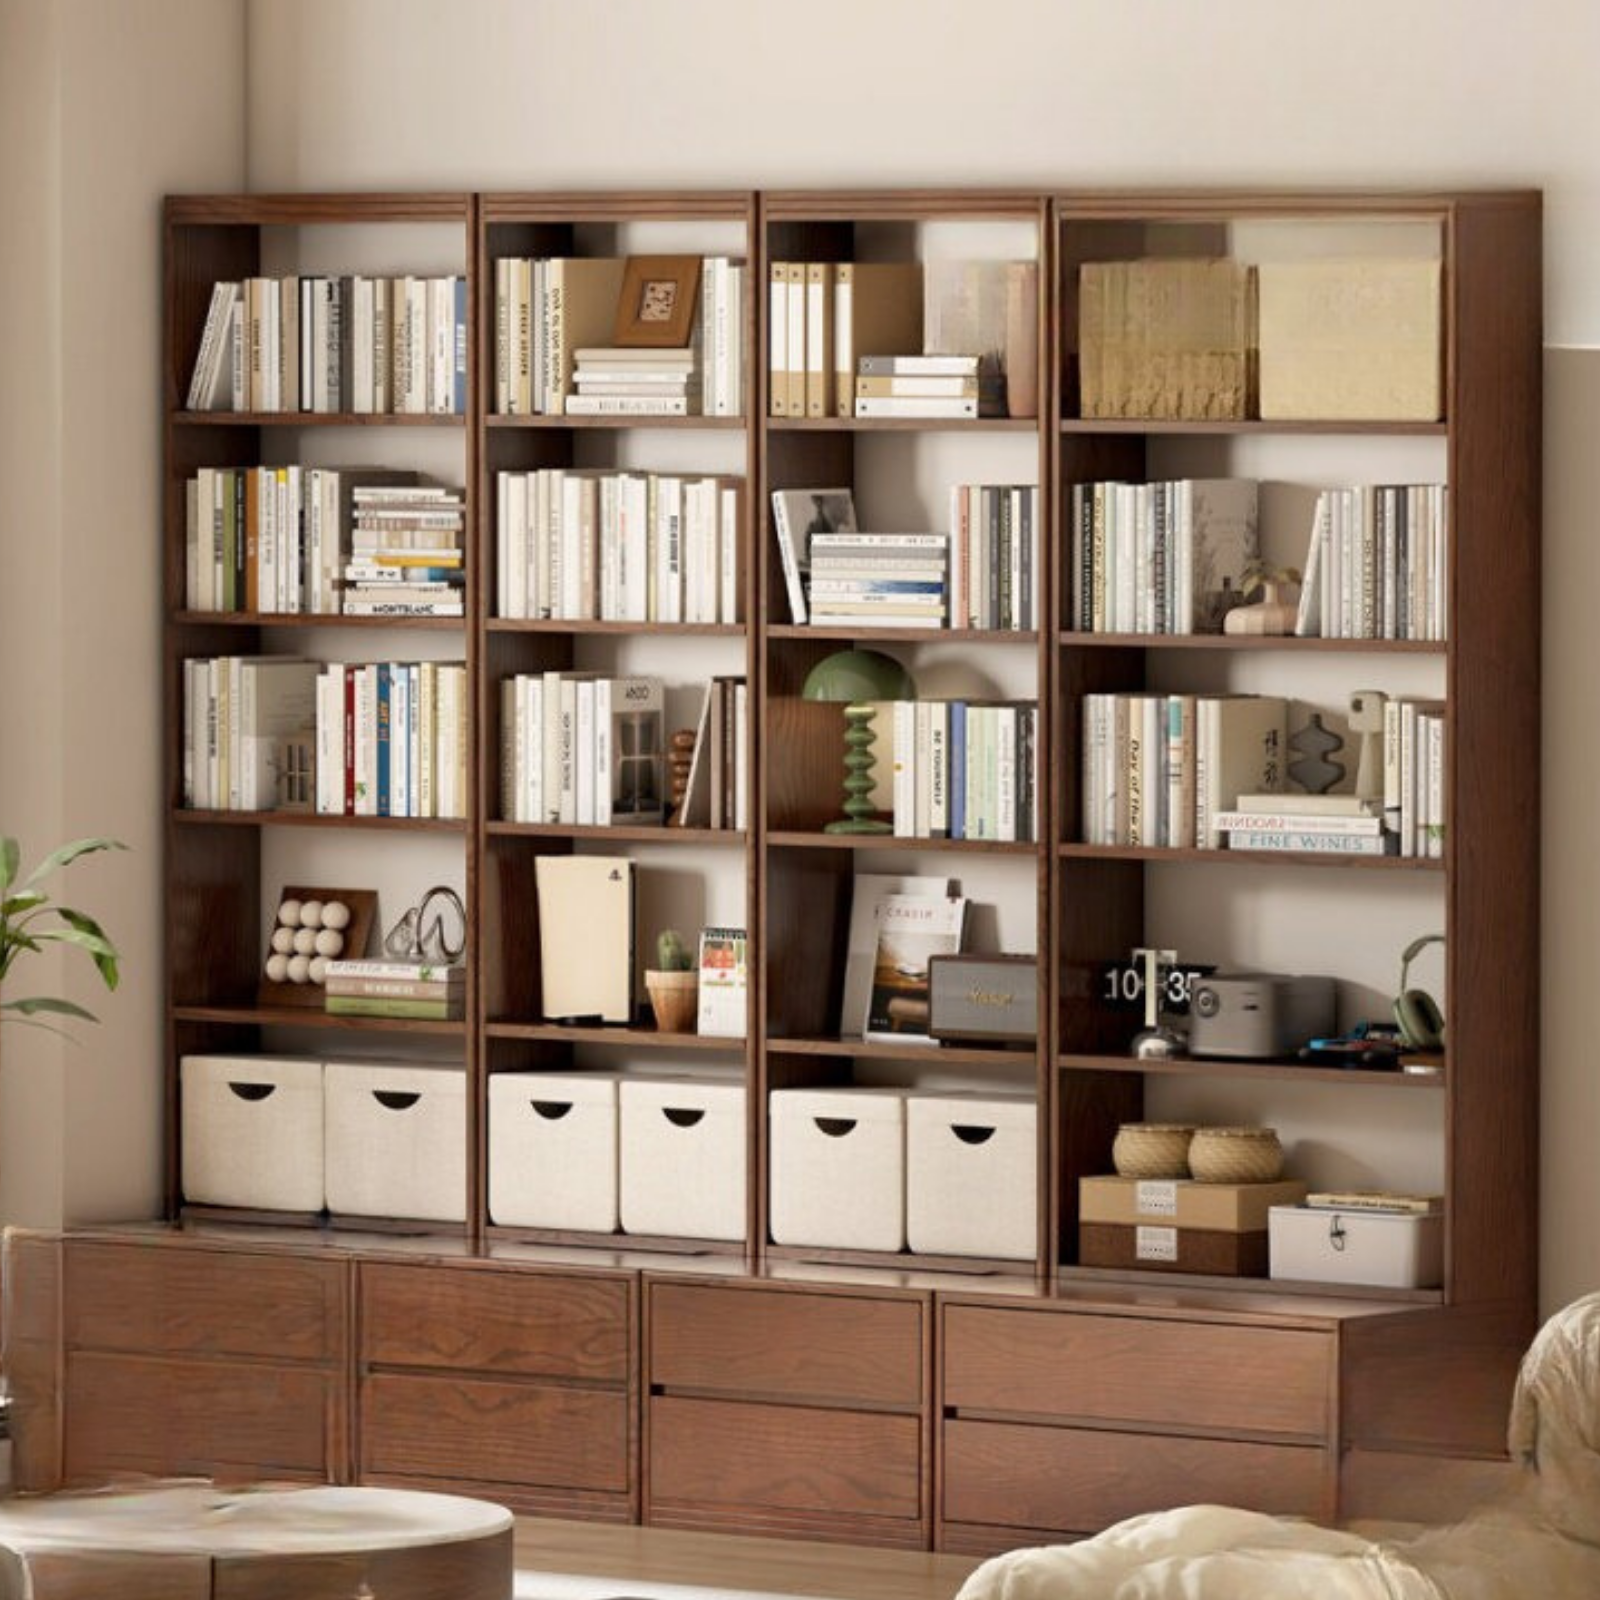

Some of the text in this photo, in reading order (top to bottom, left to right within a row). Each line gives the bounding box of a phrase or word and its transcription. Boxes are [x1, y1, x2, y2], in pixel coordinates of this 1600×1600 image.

[933, 729, 942, 744] BE
[1250, 834, 1364, 850] FINE WINES
[1104, 968, 1139, 1000] 10
